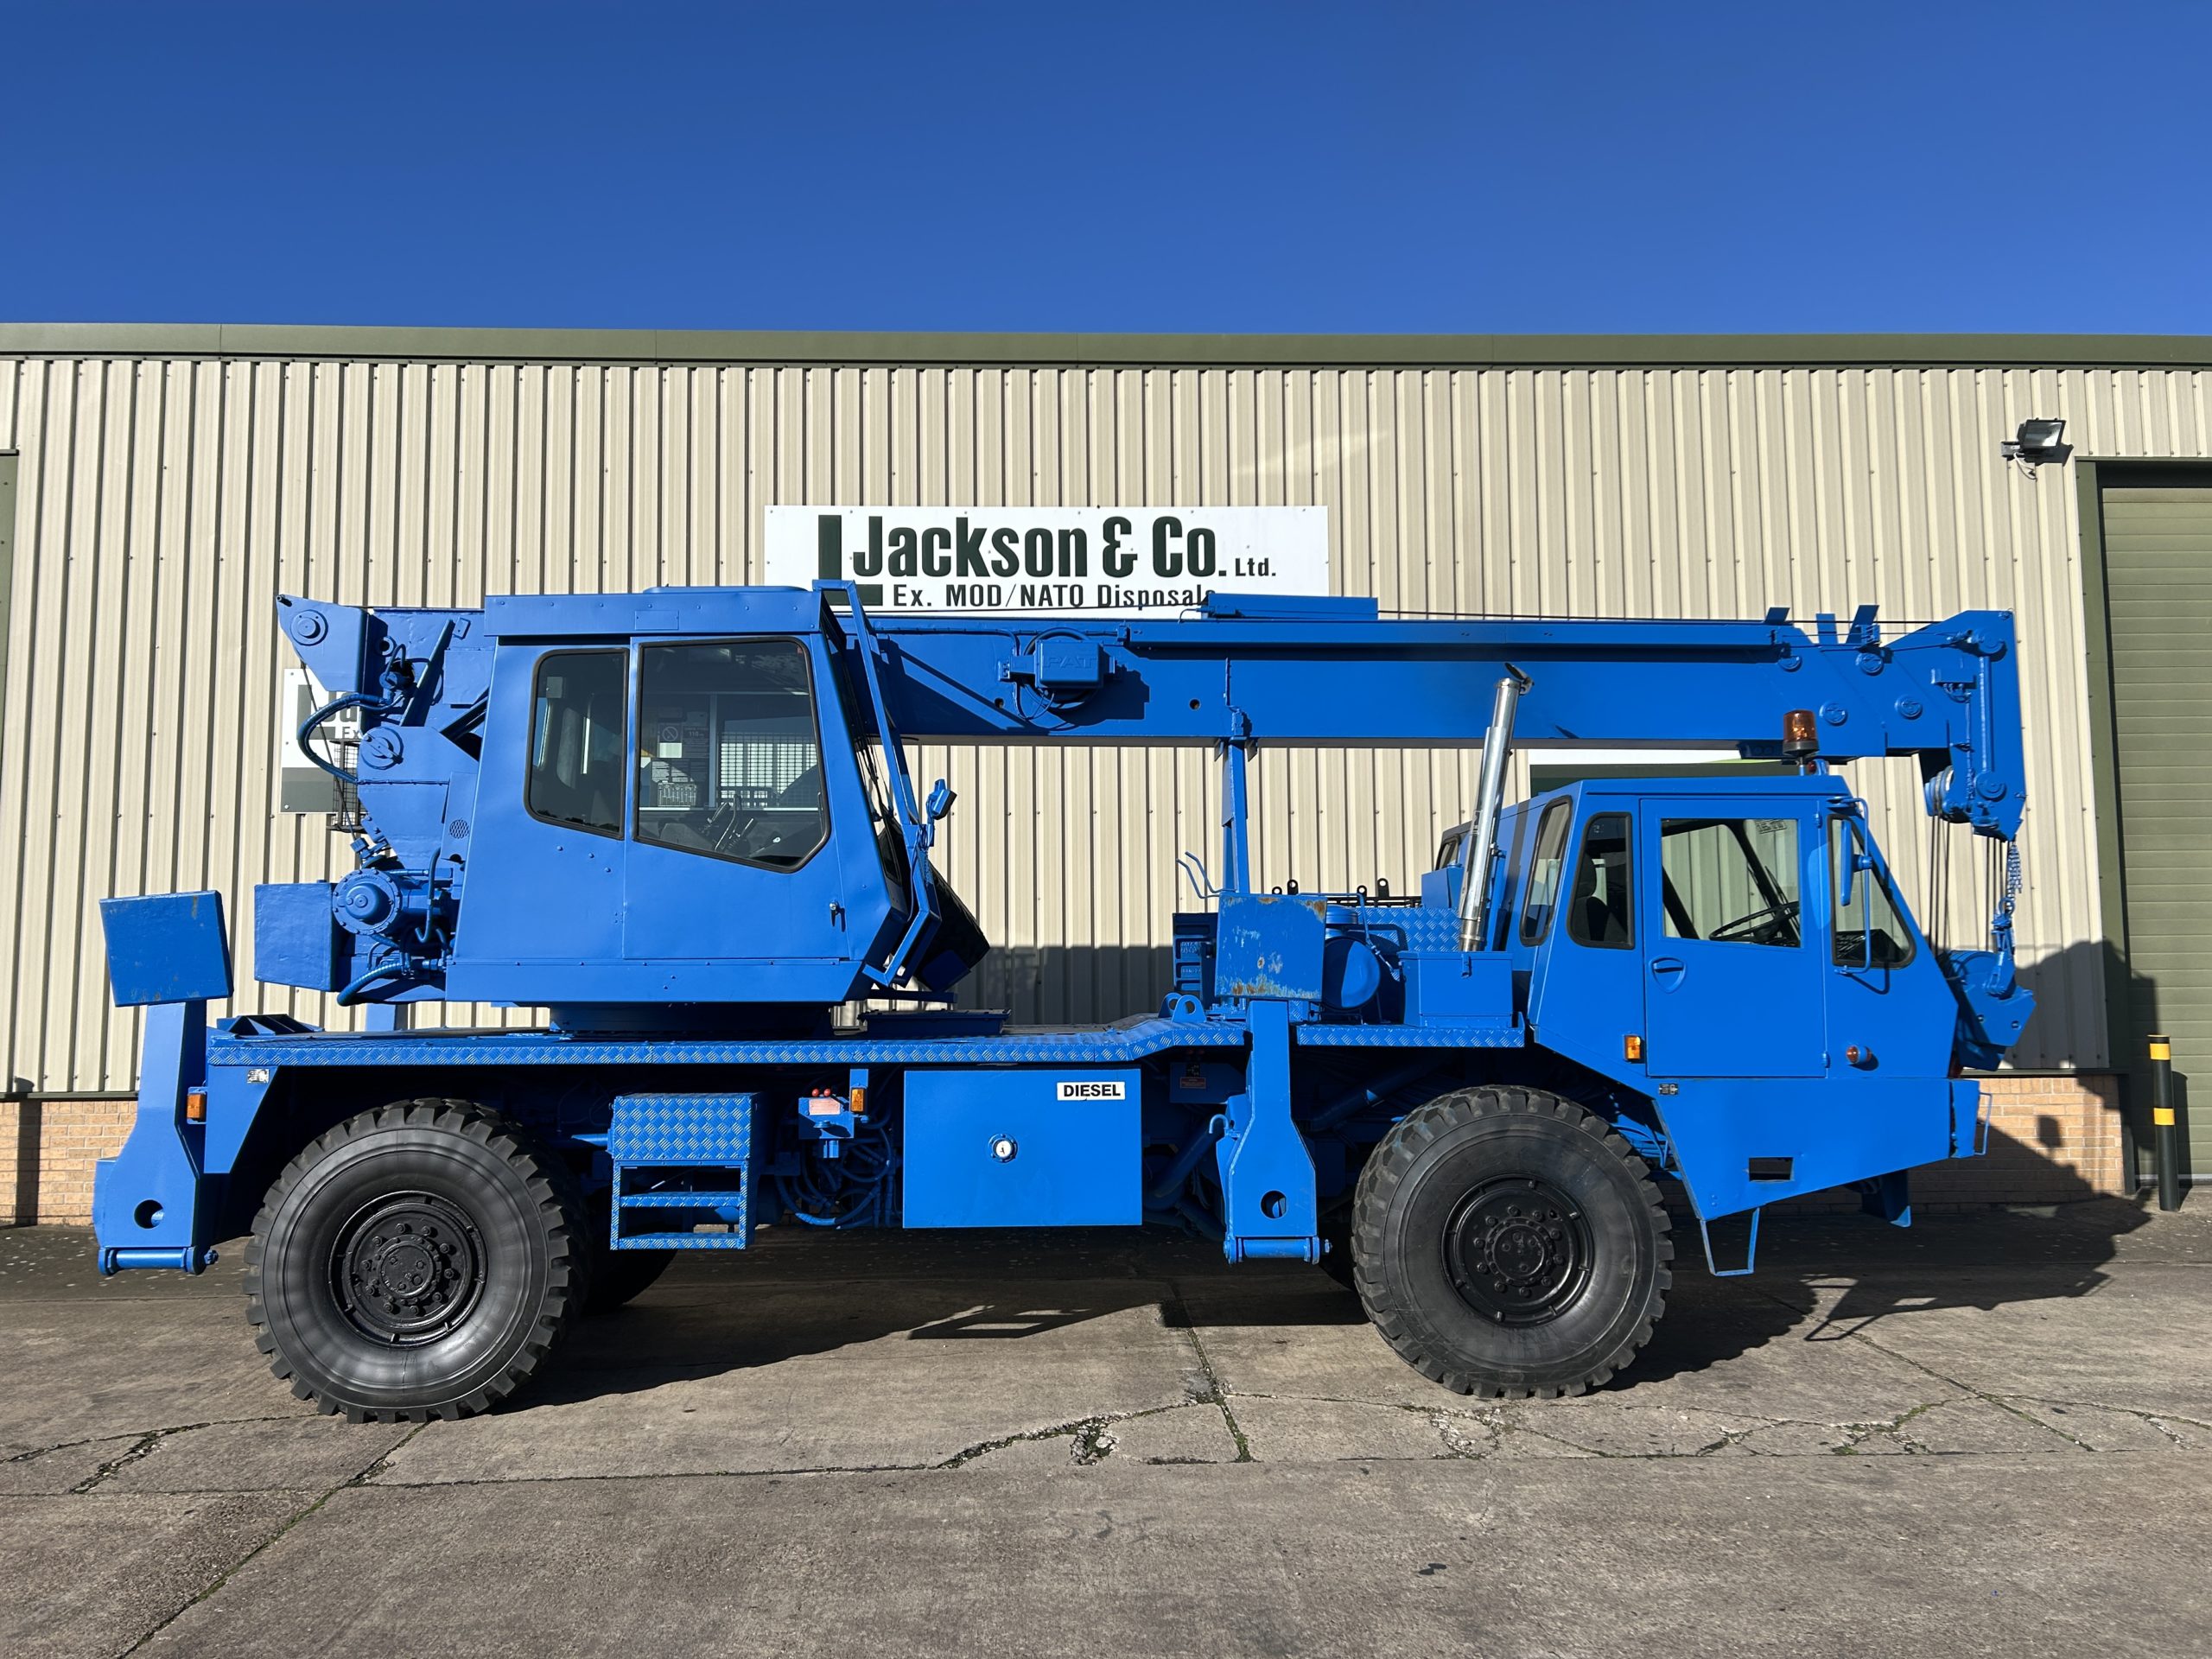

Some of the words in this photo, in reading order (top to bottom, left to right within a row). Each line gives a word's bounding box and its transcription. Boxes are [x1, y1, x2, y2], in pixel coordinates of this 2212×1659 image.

[853, 516, 1088, 577] Jackson
[1103, 516, 1138, 578] &
[1153, 516, 1227, 578] Co.
[1235, 557, 1276, 576] Ltd.
[893, 583, 932, 607] Ex.
[946, 583, 1084, 607] MOD/NATO
[1097, 584, 1216, 610] Disposal
[1064, 1084, 1121, 1096] DIESEL
